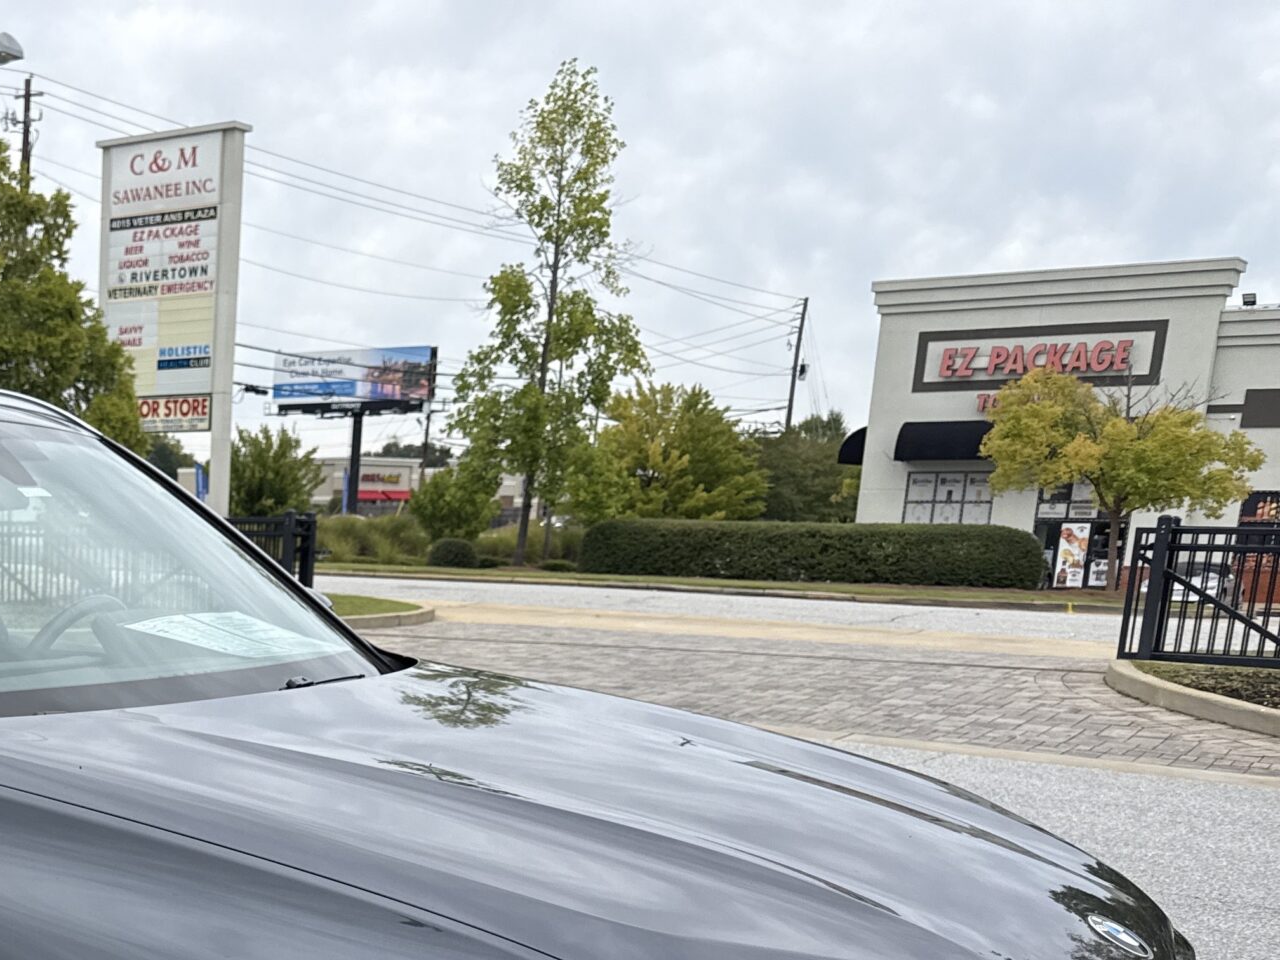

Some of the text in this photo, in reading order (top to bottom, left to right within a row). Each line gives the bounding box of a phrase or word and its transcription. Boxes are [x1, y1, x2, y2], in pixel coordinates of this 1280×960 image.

[130, 146, 198, 176] C & M
[112, 182, 182, 205] SAWANEE
[184, 207, 216, 220] PLAZA
[132, 224, 200, 242] EZ PACKAGE
[124, 245, 144, 256] BEER
[177, 239, 201, 249] WINE
[118, 258, 149, 270] LIQUOR
[168, 251, 209, 265] TOBACCO
[130, 265, 208, 283] RIVERTOWN
[160, 280, 214, 296] EMERGENCY
[159, 345, 210, 357] HOLISTIC
[939, 339, 1134, 377] EZ PACKAGE
[164, 398, 208, 417] STORE
